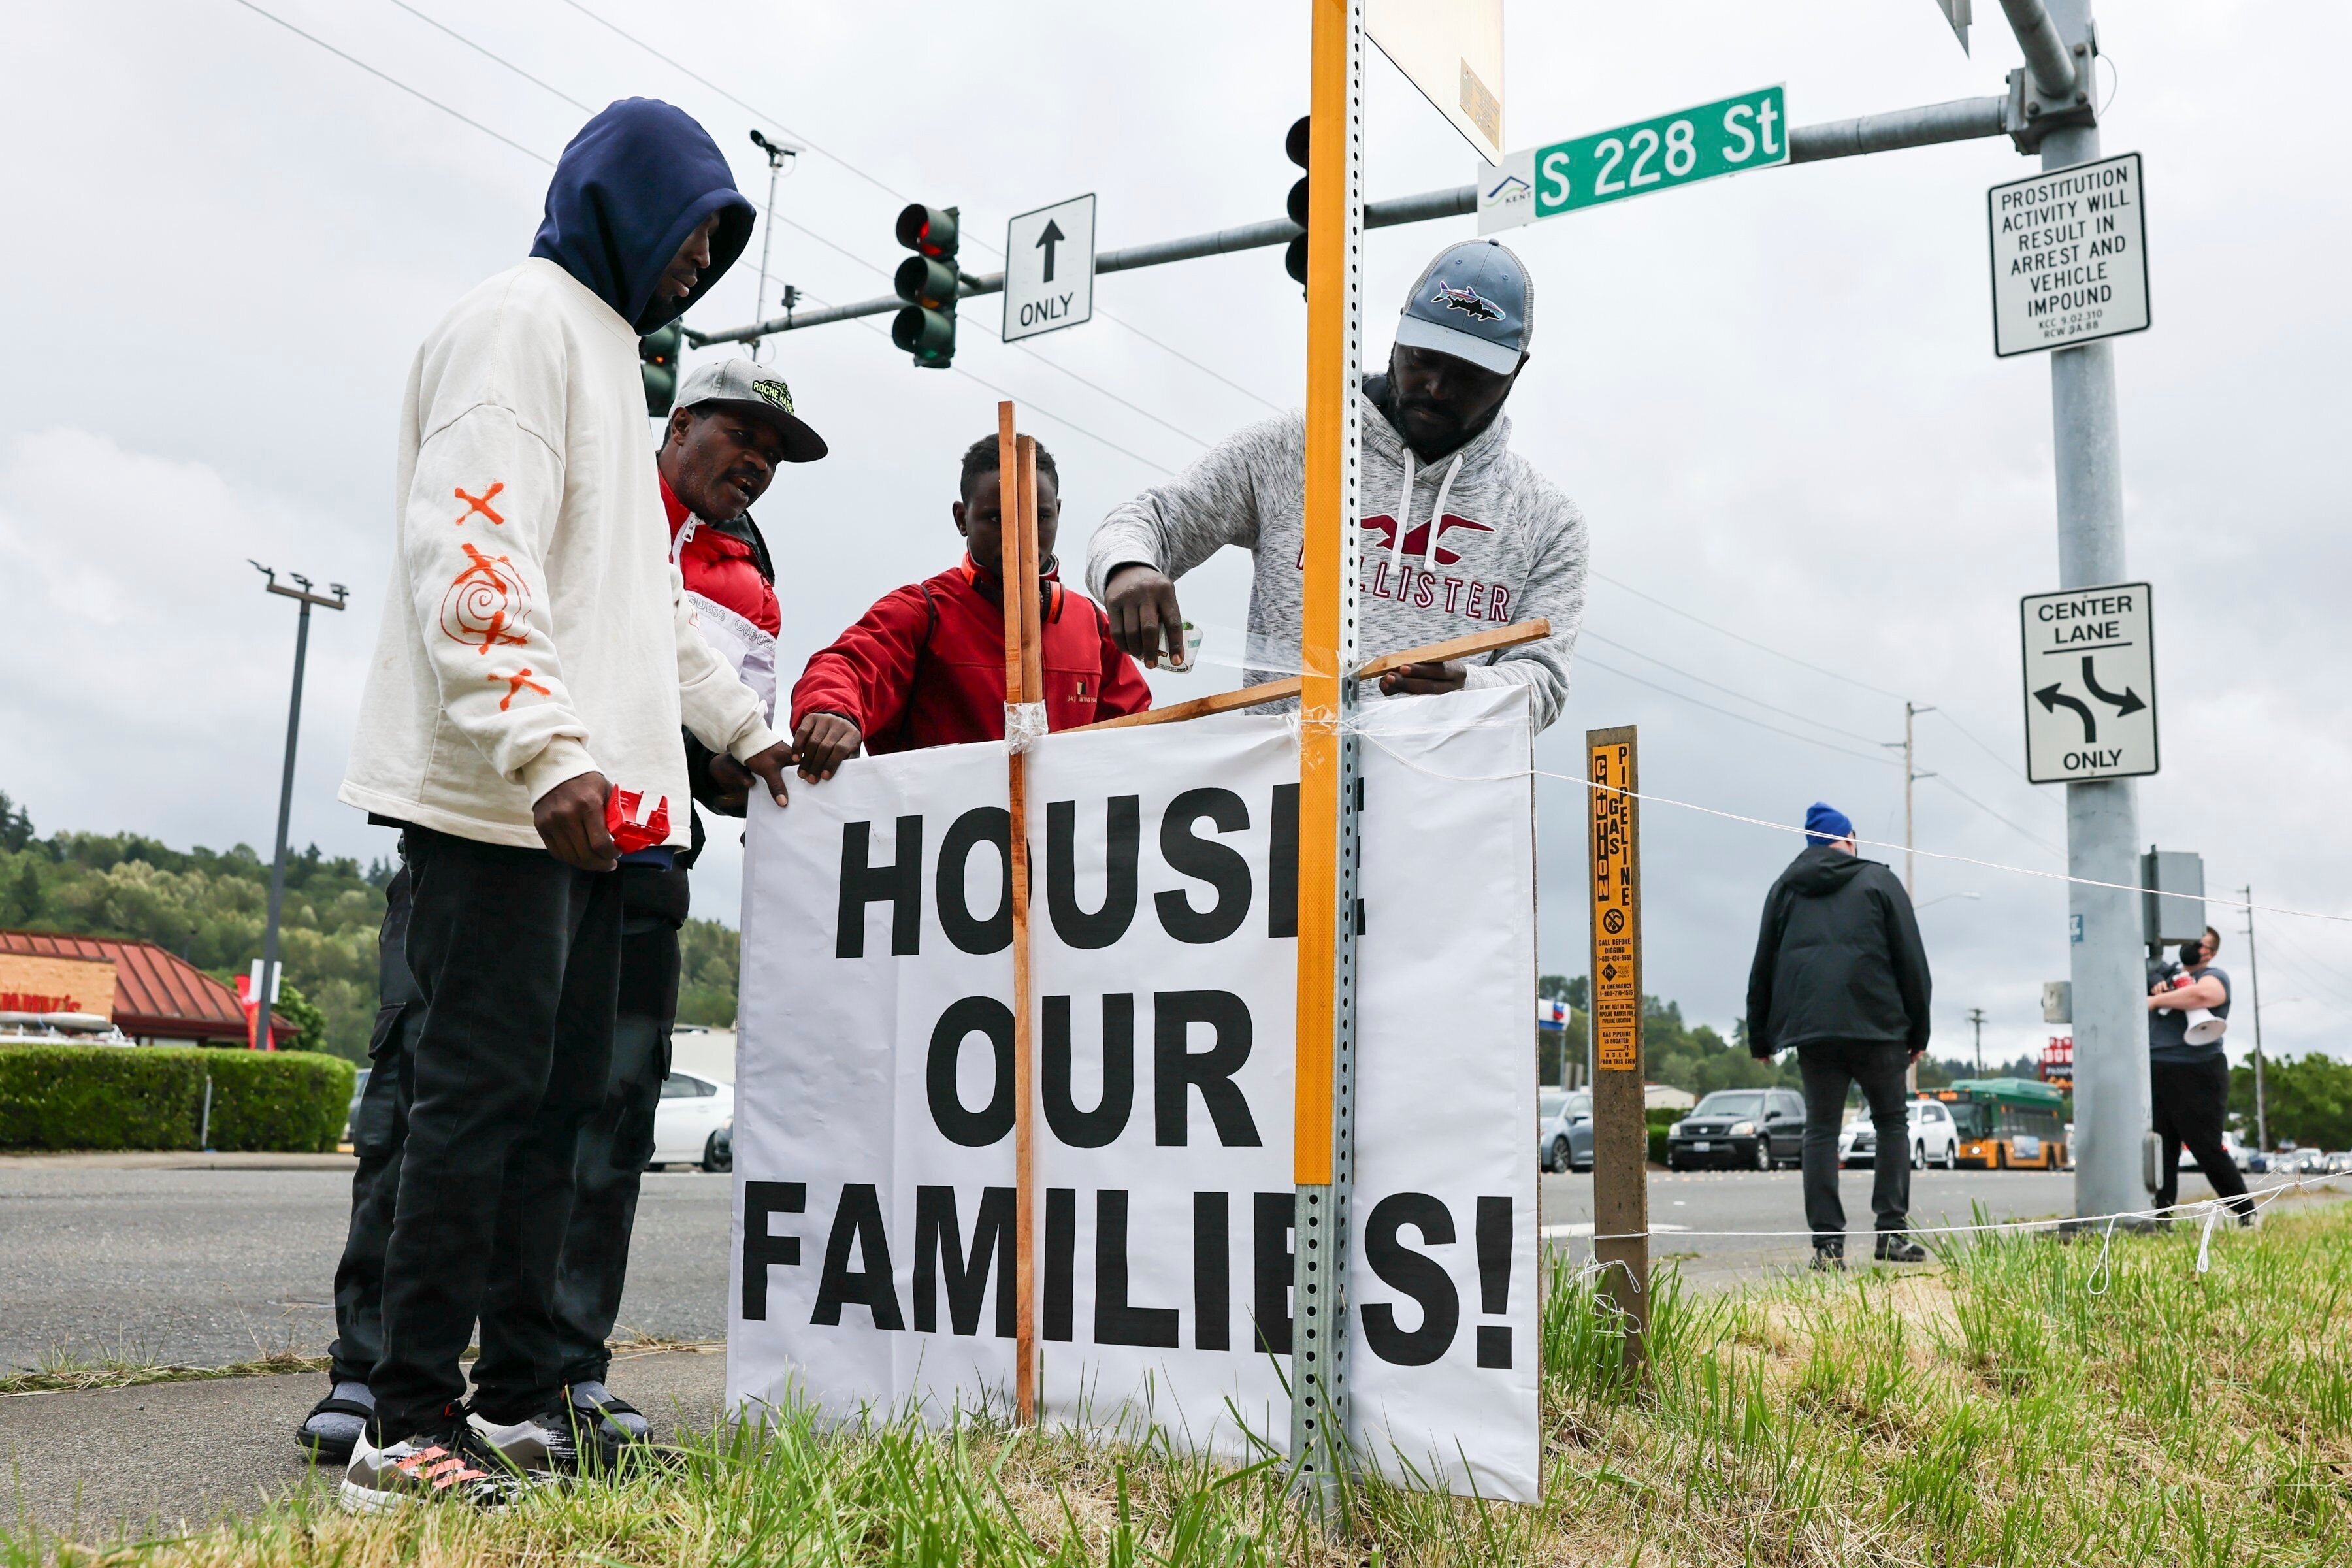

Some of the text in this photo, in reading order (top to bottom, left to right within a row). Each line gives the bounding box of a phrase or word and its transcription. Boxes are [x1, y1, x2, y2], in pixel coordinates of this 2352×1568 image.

[1540, 97, 1780, 207] S 228 St
[1506, 191, 1531, 204] KENT
[2002, 165, 2128, 211] PROSTITUTION
[2002, 189, 2131, 233] ACTIVITY WILL
[2019, 214, 2115, 252] RESULT IN
[2010, 235, 2126, 276] ARREST AND
[2030, 261, 2108, 293] VEHICLE
[1020, 291, 1074, 327] ONLY
[2027, 284, 2112, 318] IMPOUND
[2039, 318, 2057, 329] KCC
[2044, 327, 2065, 338] RCW
[753, 381, 779, 399] ROCHE
[1296, 538, 1511, 623] LISTER
[688, 595, 726, 621] GUESS
[2038, 595, 2132, 622] CENTER
[2055, 621, 2121, 644] LANE
[2063, 748, 2123, 771] ONLY
[1596, 759, 1609, 898] CAUTION
[1609, 798, 1620, 855] GAS
[1618, 746, 1631, 906] PIPELINE
[1604, 968, 1616, 977] PSE
[926, 990, 1263, 1149] OUR
